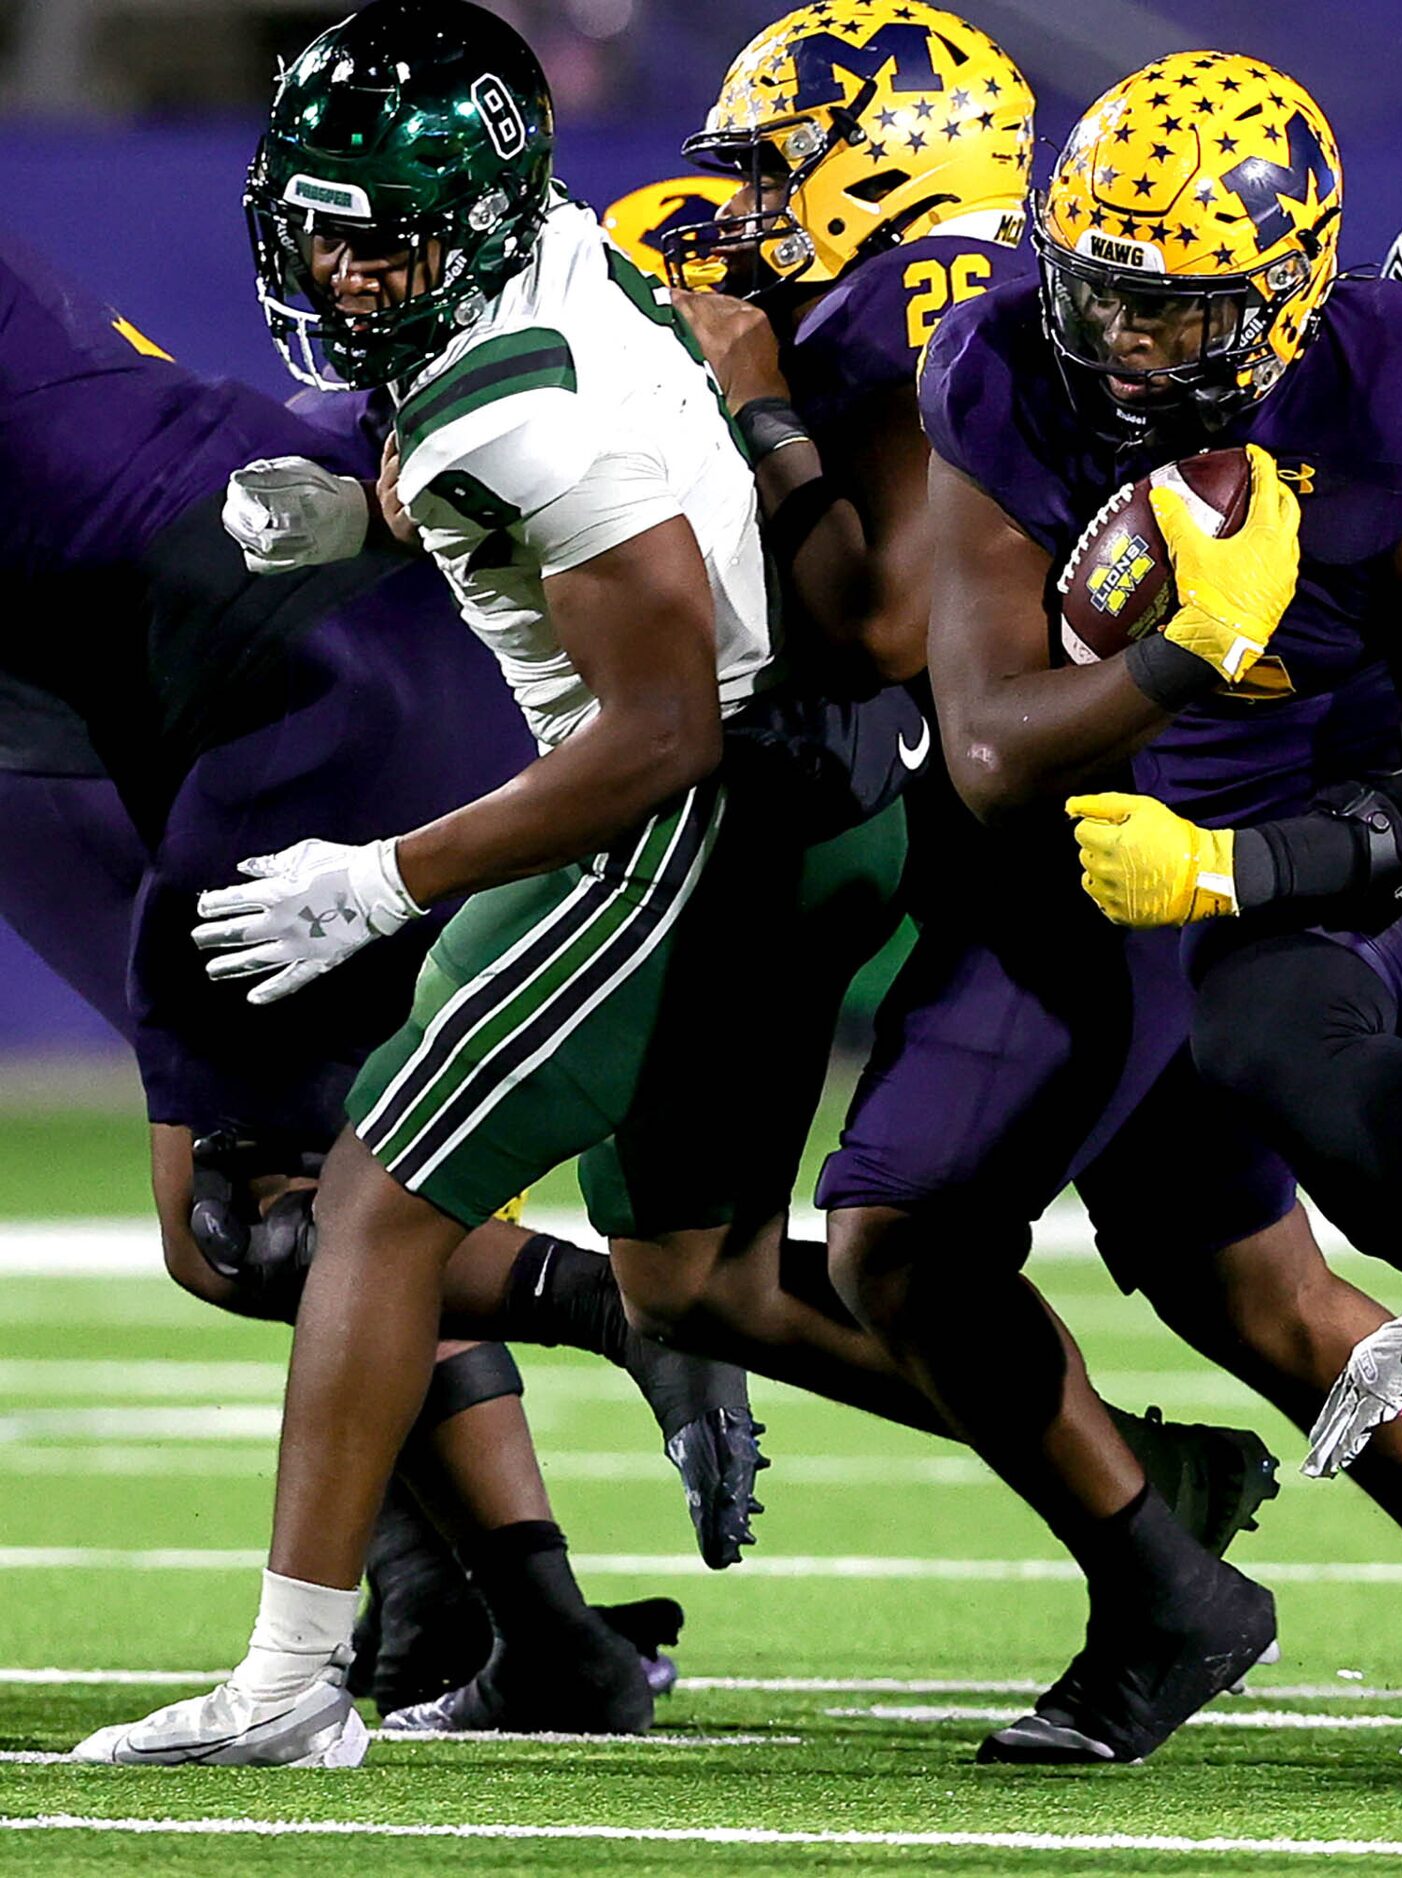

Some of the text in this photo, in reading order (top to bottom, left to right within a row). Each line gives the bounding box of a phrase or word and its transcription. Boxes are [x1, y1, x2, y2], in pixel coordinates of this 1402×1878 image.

[786, 22, 943, 112] M
[470, 72, 525, 160] 8
[1219, 109, 1336, 254] M
[1090, 234, 1145, 267] WAWG
[902, 252, 992, 348] 26
[1096, 543, 1141, 604] LIONS
